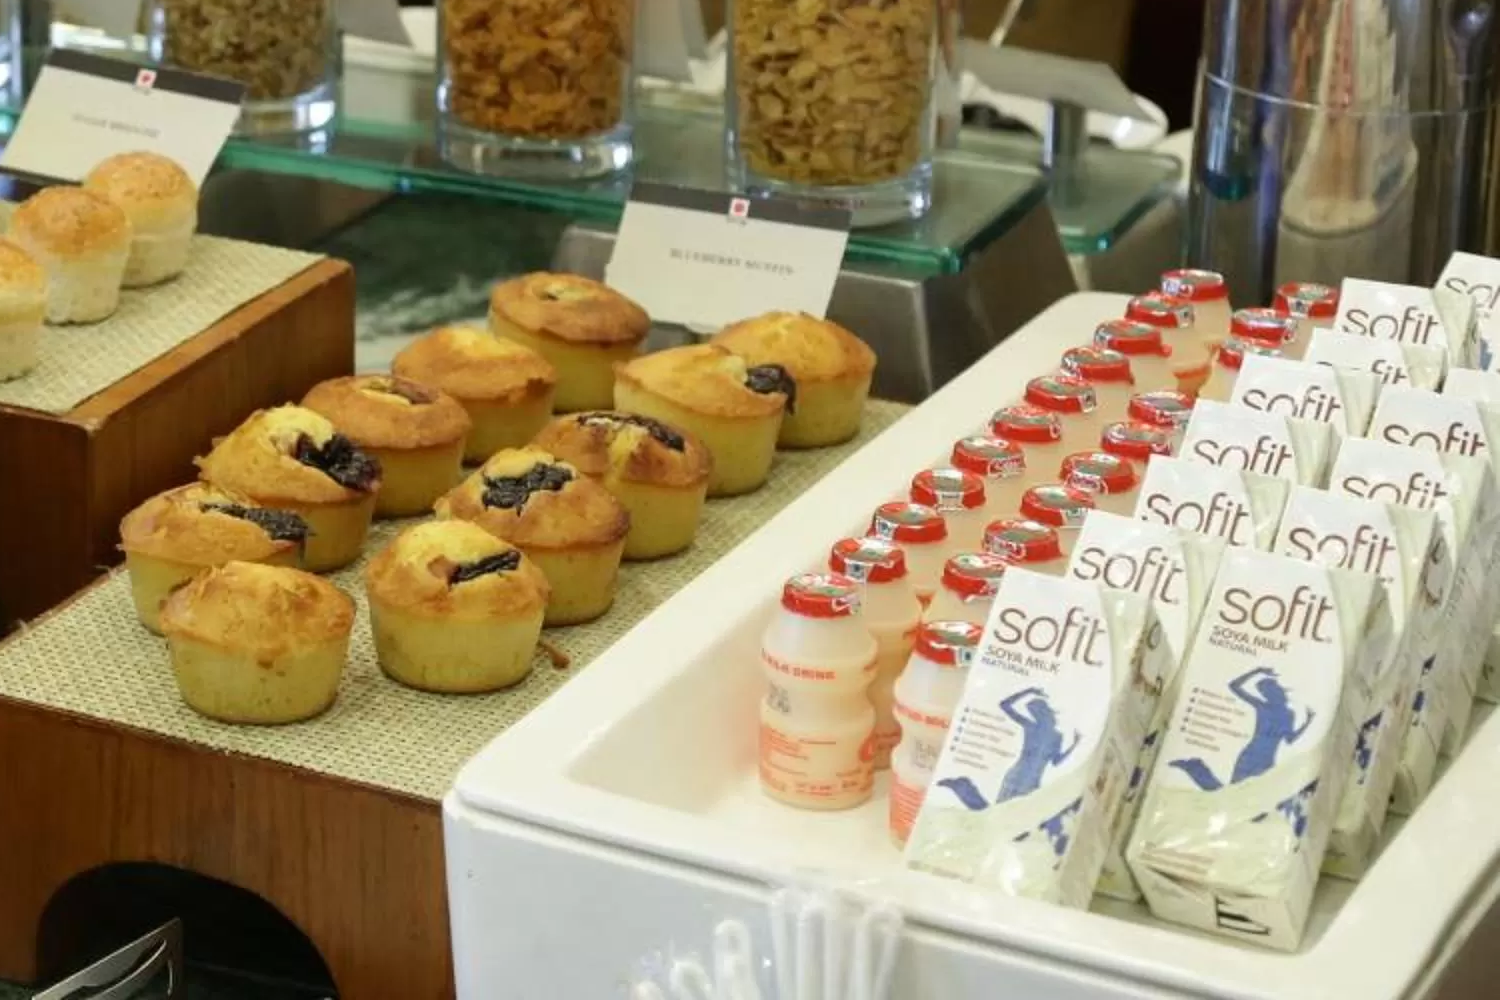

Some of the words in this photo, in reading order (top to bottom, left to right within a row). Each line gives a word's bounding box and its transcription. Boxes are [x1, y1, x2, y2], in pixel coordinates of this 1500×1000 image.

[1072, 547, 1184, 604] sofit
[993, 606, 1107, 668] sofit
[1212, 625, 1251, 645] SOYA
[1253, 634, 1289, 652] MILK
[1219, 585, 1333, 642] sofit
[986, 645, 1022, 665] SOYA
[1025, 656, 1060, 675] MILK
